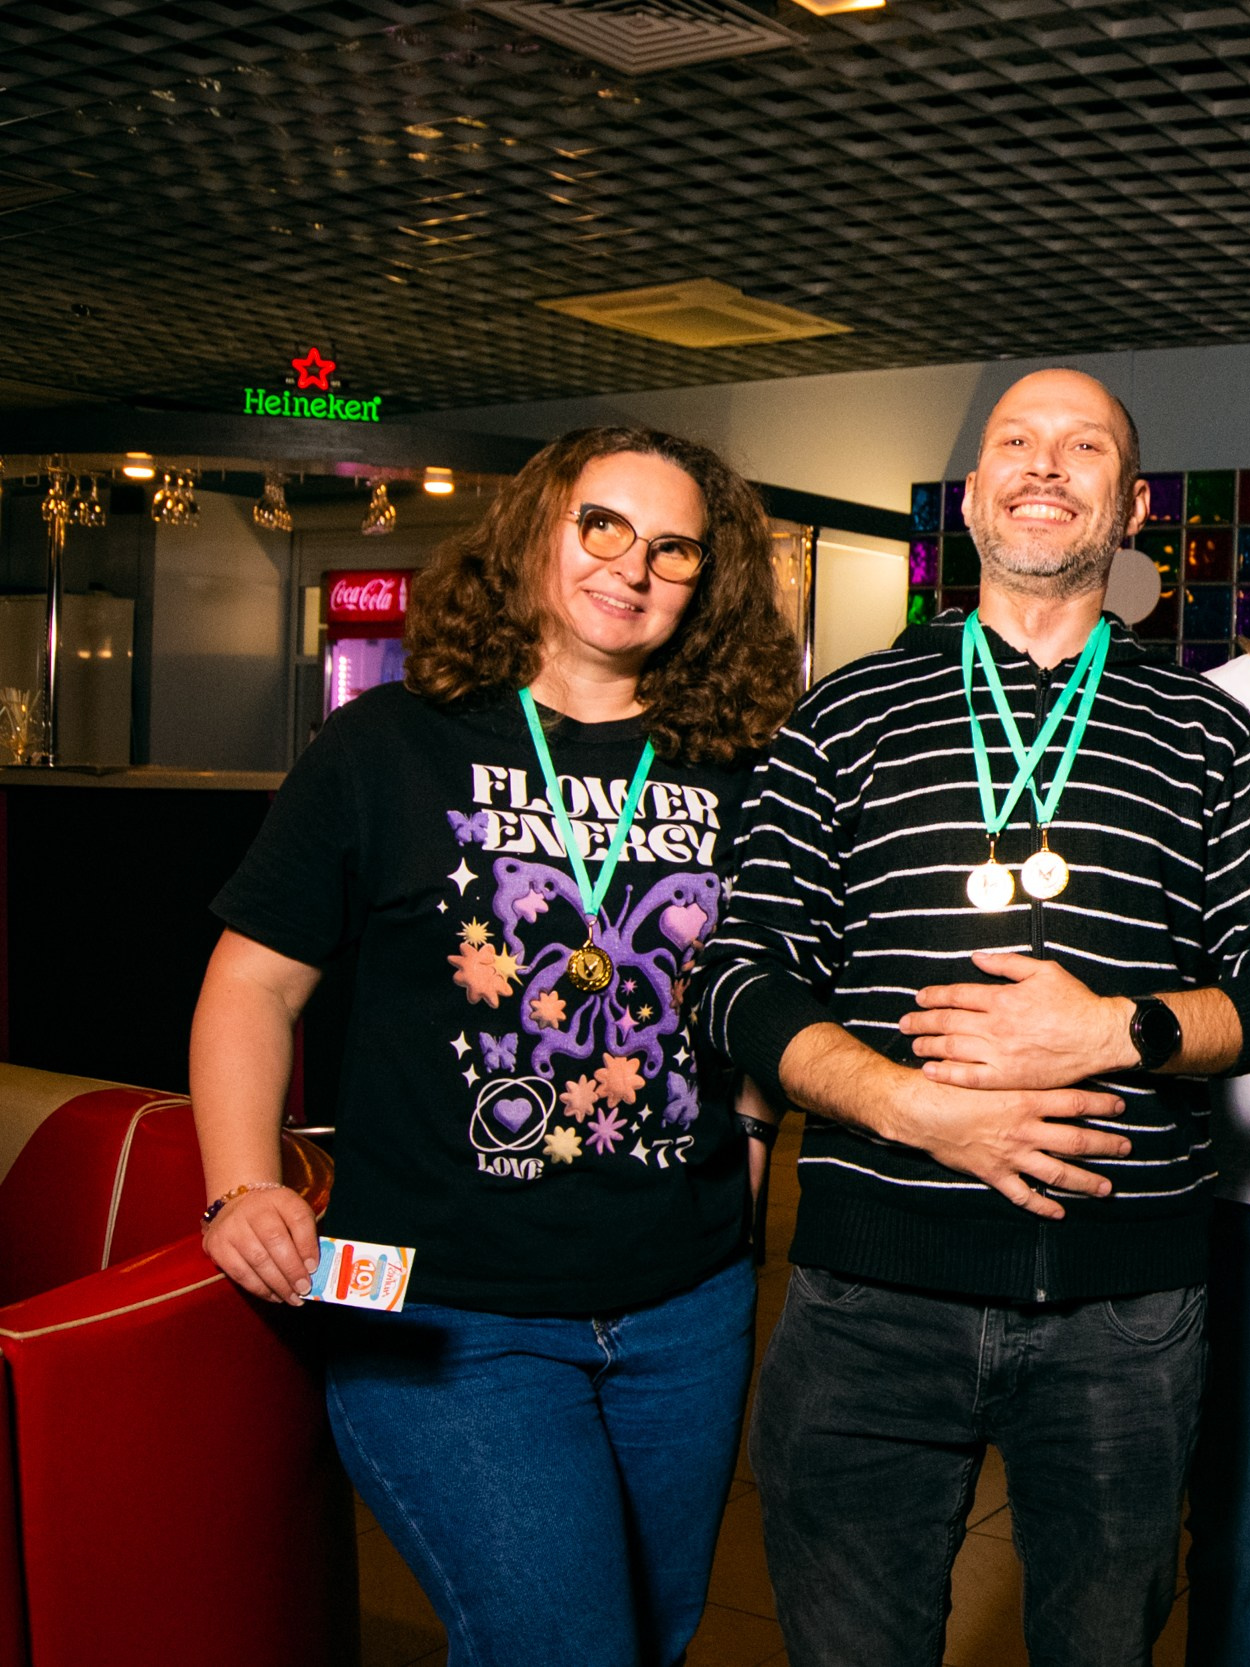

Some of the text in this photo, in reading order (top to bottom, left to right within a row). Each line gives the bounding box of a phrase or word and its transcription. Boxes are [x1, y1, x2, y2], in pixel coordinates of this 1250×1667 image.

[243, 388, 381, 422] Heineken
[471, 763, 721, 830] FLOWER
[481, 808, 717, 866] ENERGY
[477, 1152, 545, 1180] LOVE
